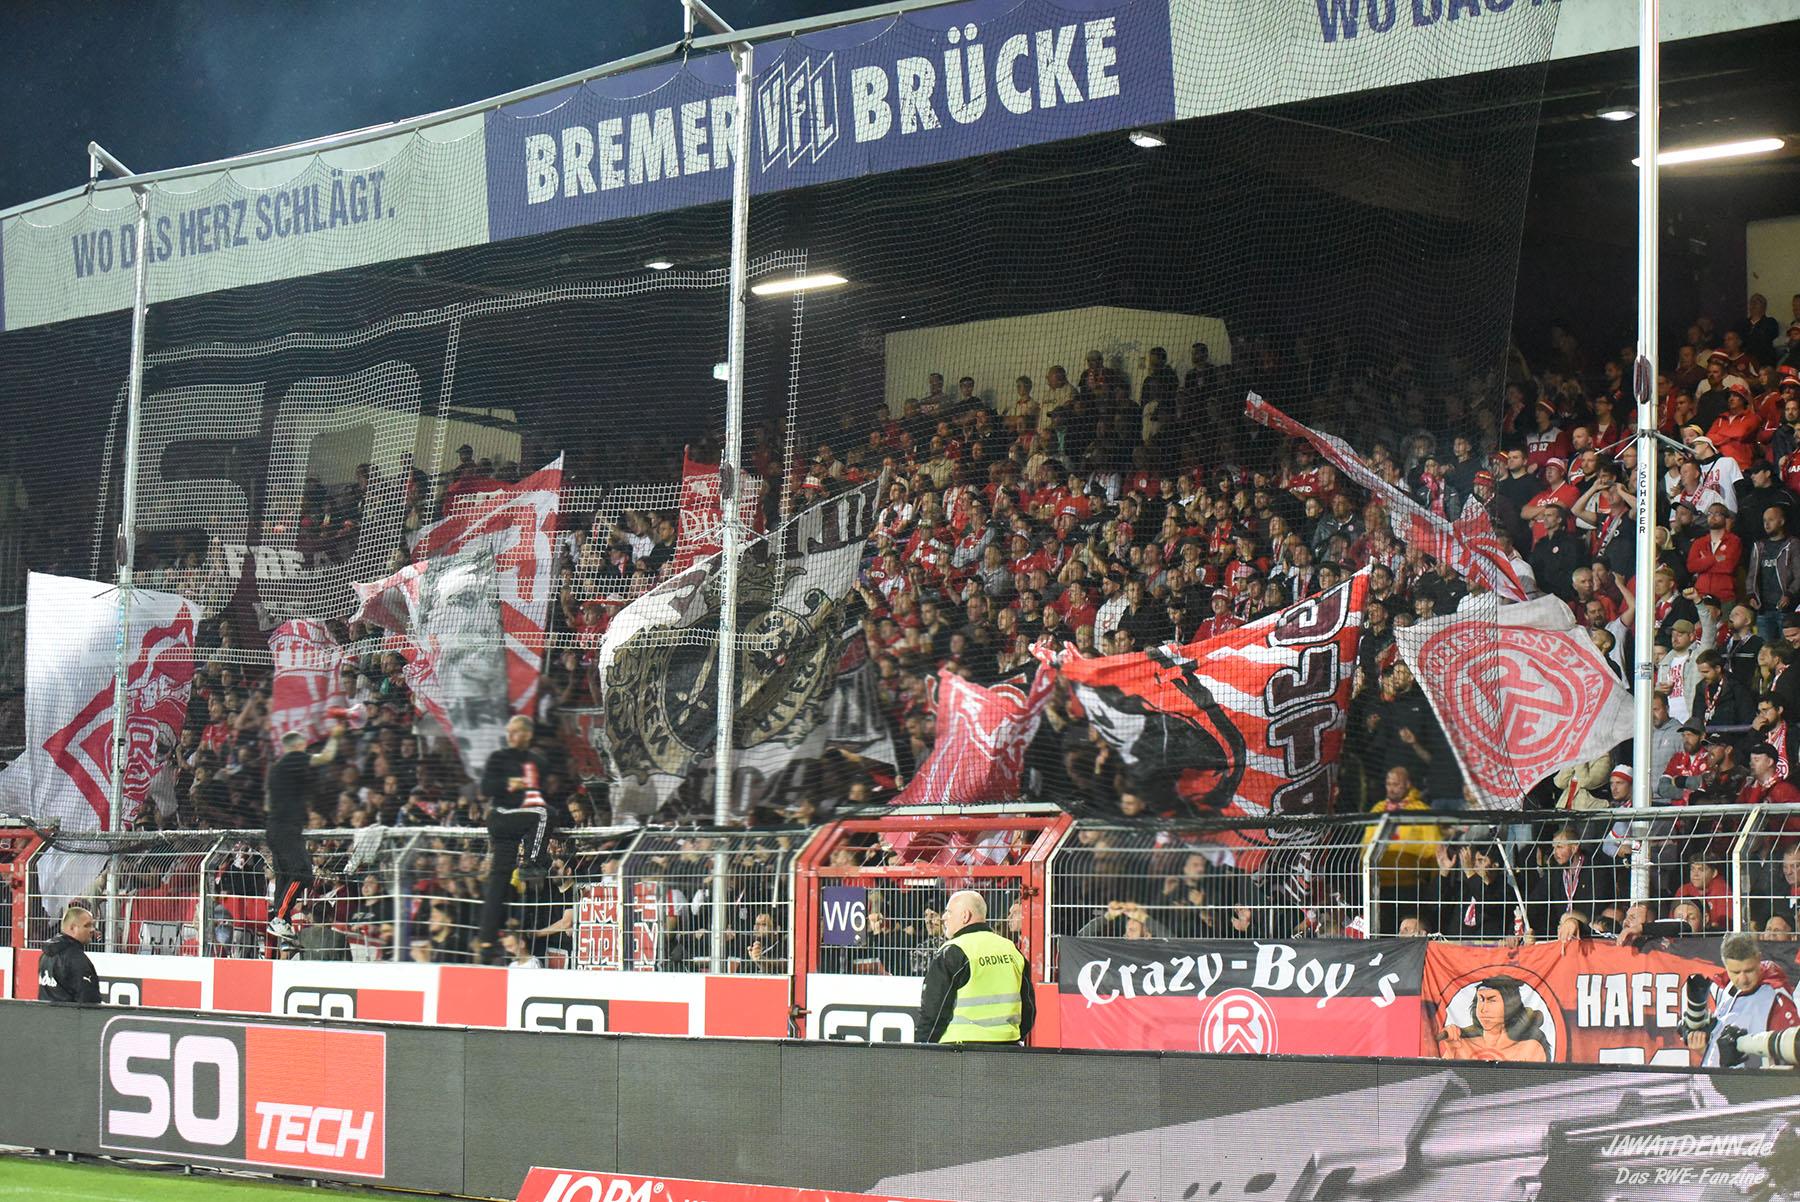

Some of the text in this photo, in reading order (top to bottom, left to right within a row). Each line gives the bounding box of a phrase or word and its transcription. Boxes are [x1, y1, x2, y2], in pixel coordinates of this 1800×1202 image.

[525, 95, 738, 205] BREMER
[851, 17, 1121, 144] BRÜCKE
[72, 231, 113, 278] WO
[179, 199, 249, 257] HERZ
[255, 168, 396, 241] SCHLÄGT.
[1638, 471, 1647, 534] SCHAPER
[823, 901, 866, 931] W6
[1576, 973, 1688, 1028] HAFE
[109, 1031, 239, 1145] SO
[255, 1101, 374, 1159] TECH
